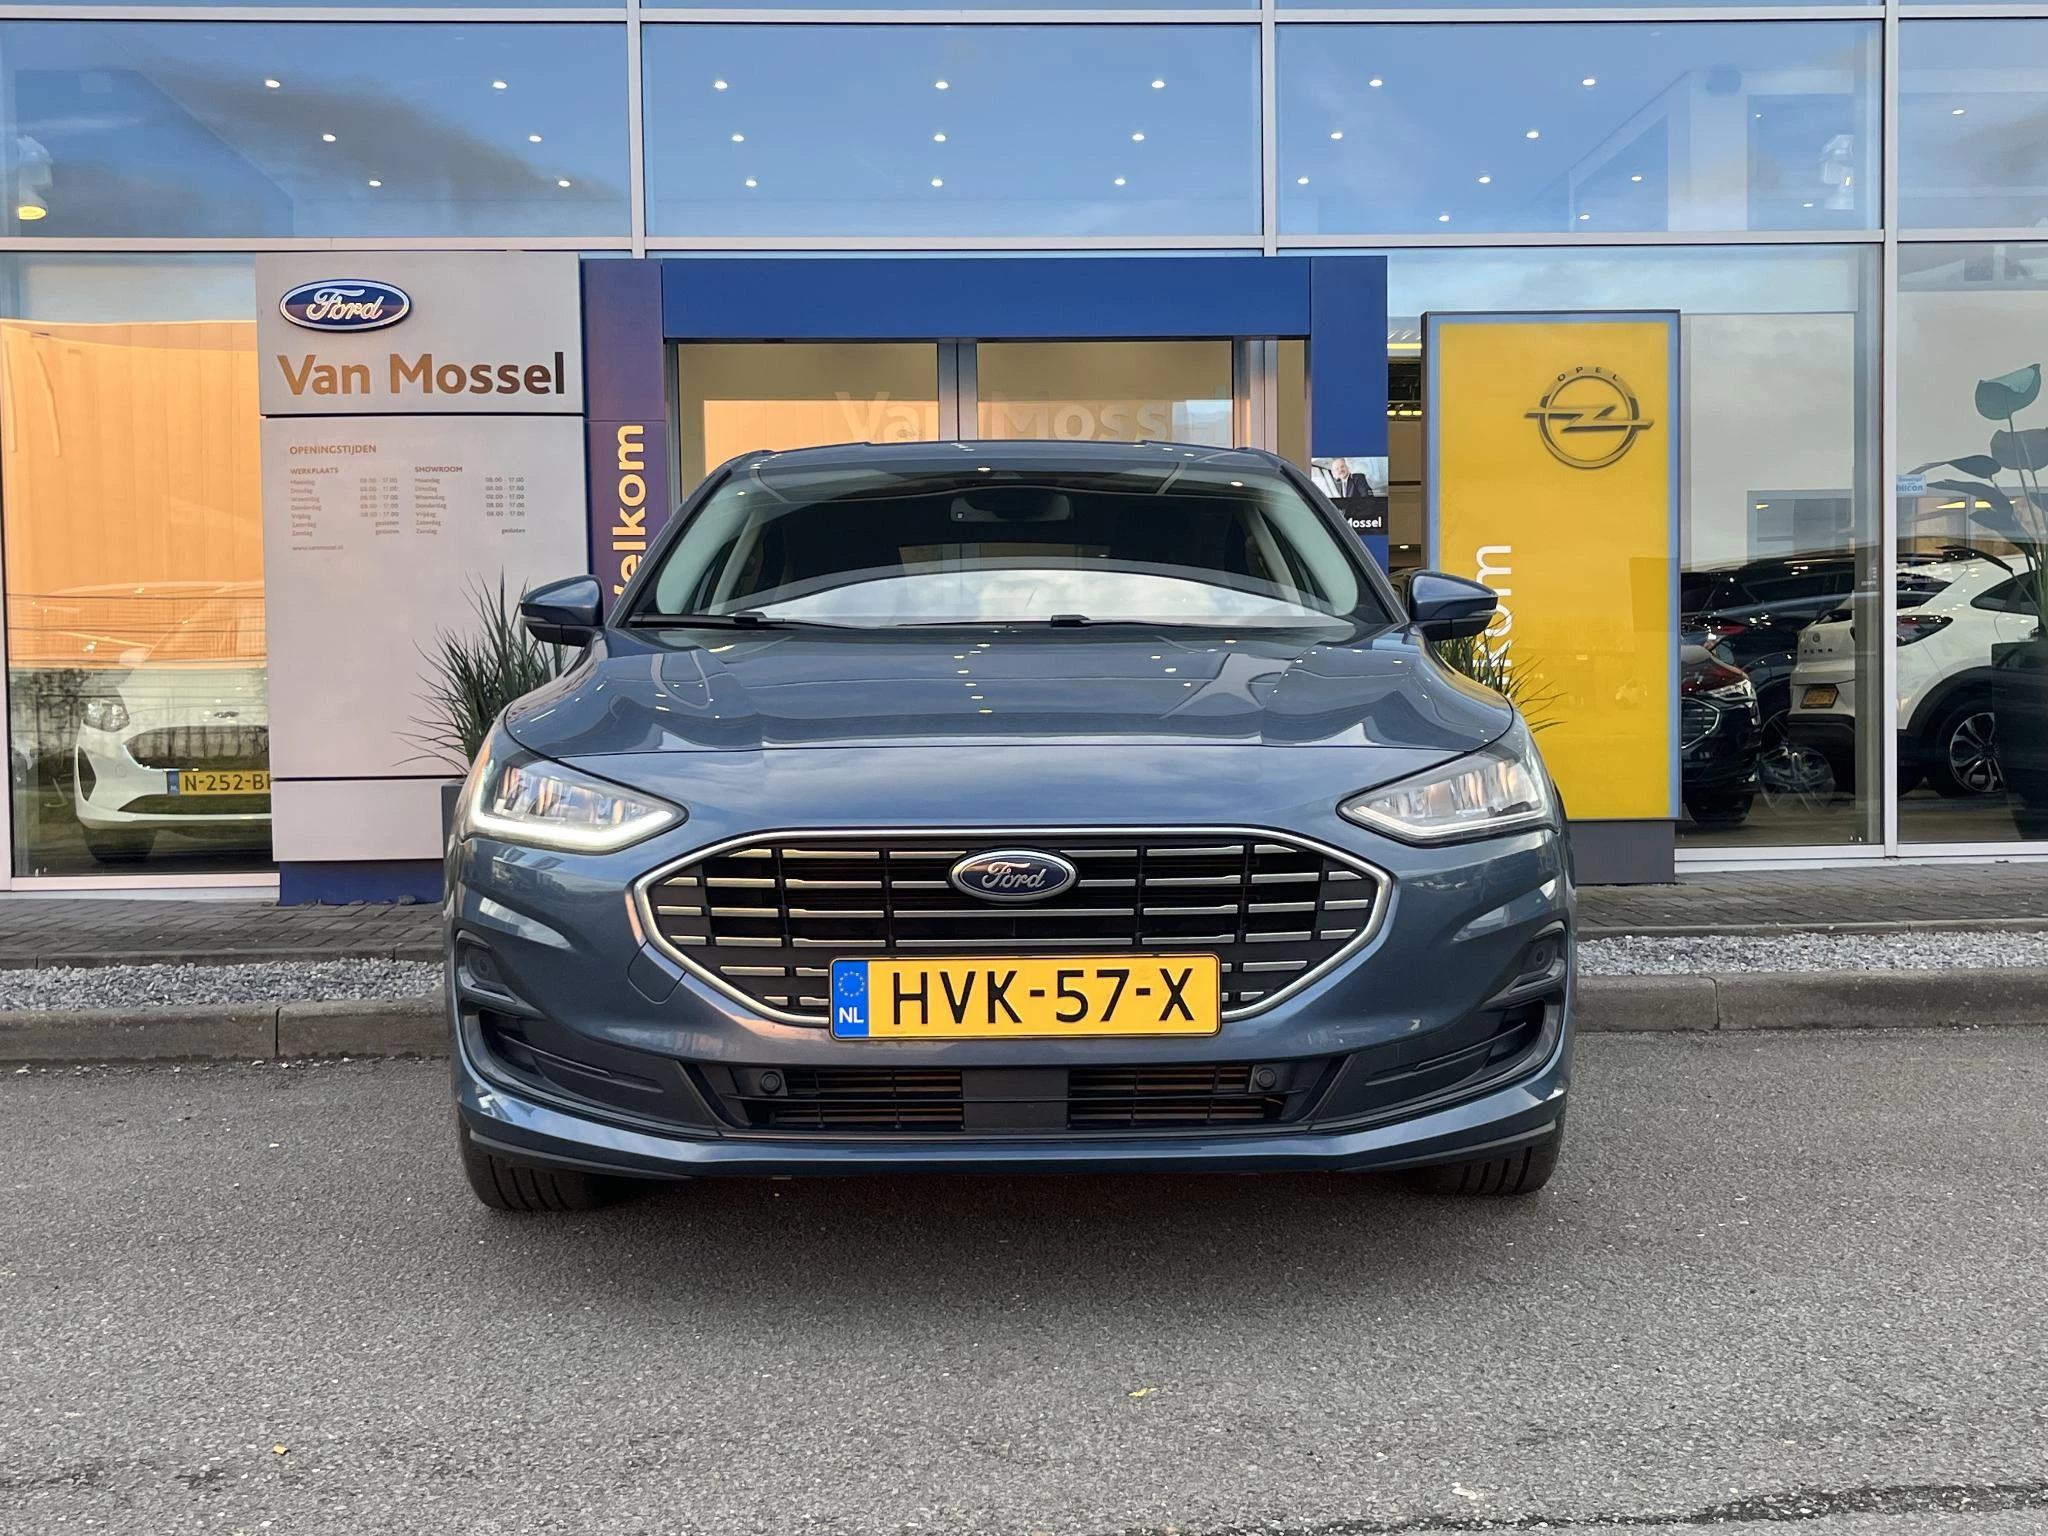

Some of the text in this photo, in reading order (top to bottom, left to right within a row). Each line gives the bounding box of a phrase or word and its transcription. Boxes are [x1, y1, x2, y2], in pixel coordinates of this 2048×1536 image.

[306, 288, 384, 320] Ford
[277, 352, 565, 395] Van Mossel
[1557, 366, 1617, 381] OPEL
[289, 444, 377, 455] OPENINGSTIJDEN
[290, 467, 339, 475] WERKPLAATS
[613, 425, 647, 597] elkom
[982, 861, 1046, 888] Ford
[839, 968, 1195, 1025] NL HVK-57-X
